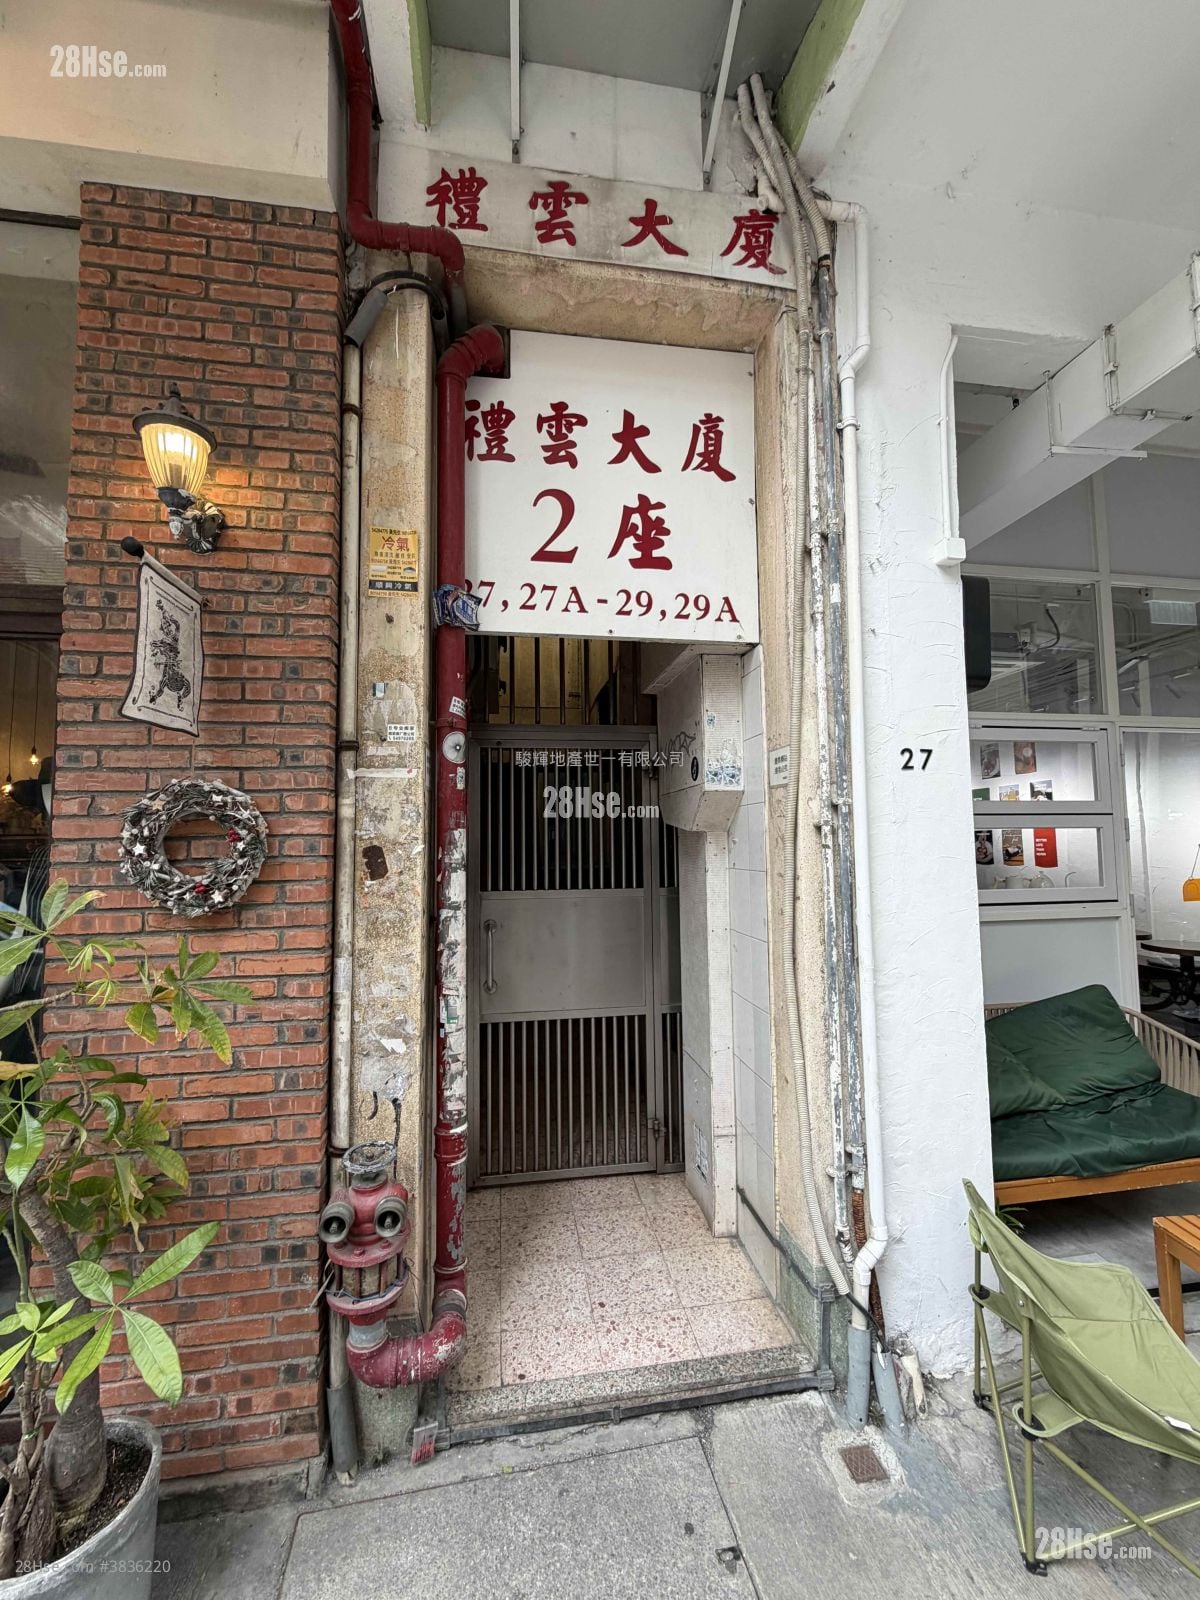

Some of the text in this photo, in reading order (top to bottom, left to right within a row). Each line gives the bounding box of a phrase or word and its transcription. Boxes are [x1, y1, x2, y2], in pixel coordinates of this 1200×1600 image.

[426, 166, 787, 275] 禮雲大廈
[465, 400, 737, 482] 禮雲大廈
[382, 536, 410, 552] 冷氣
[900, 748, 933, 771] 27
